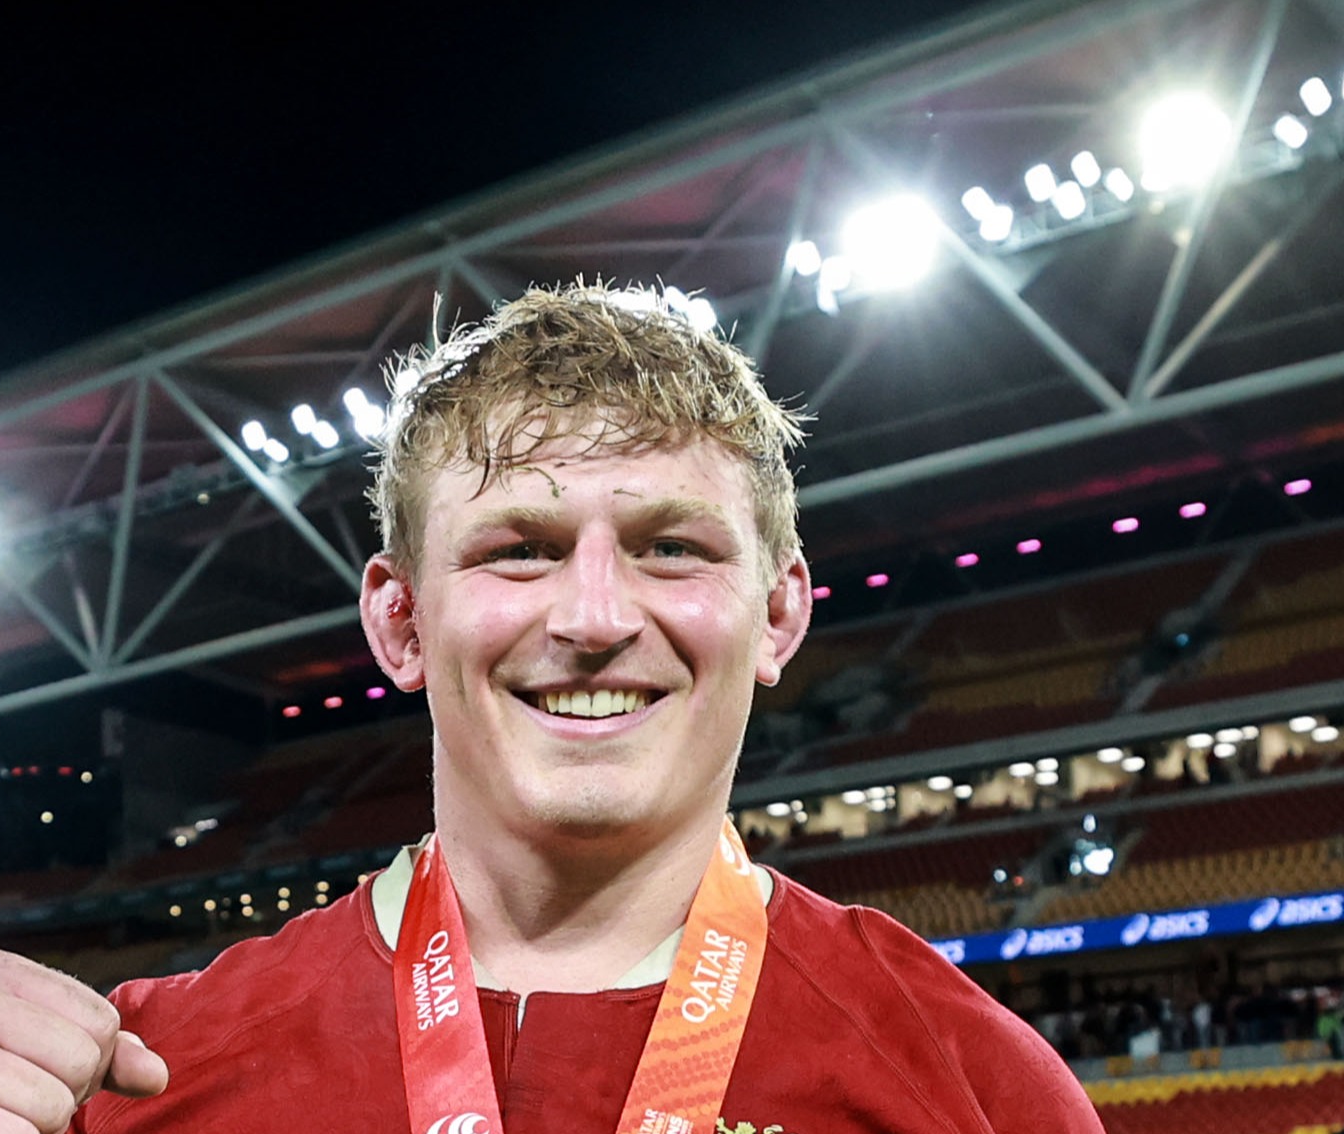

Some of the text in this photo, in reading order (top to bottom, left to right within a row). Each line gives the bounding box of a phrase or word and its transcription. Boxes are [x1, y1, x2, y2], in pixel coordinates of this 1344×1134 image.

[412, 963, 434, 1031] AIRWAYS
[423, 930, 460, 1024] QATAR
[681, 929, 732, 1023] QATAR
[719, 938, 748, 1012] AIRWAYS
